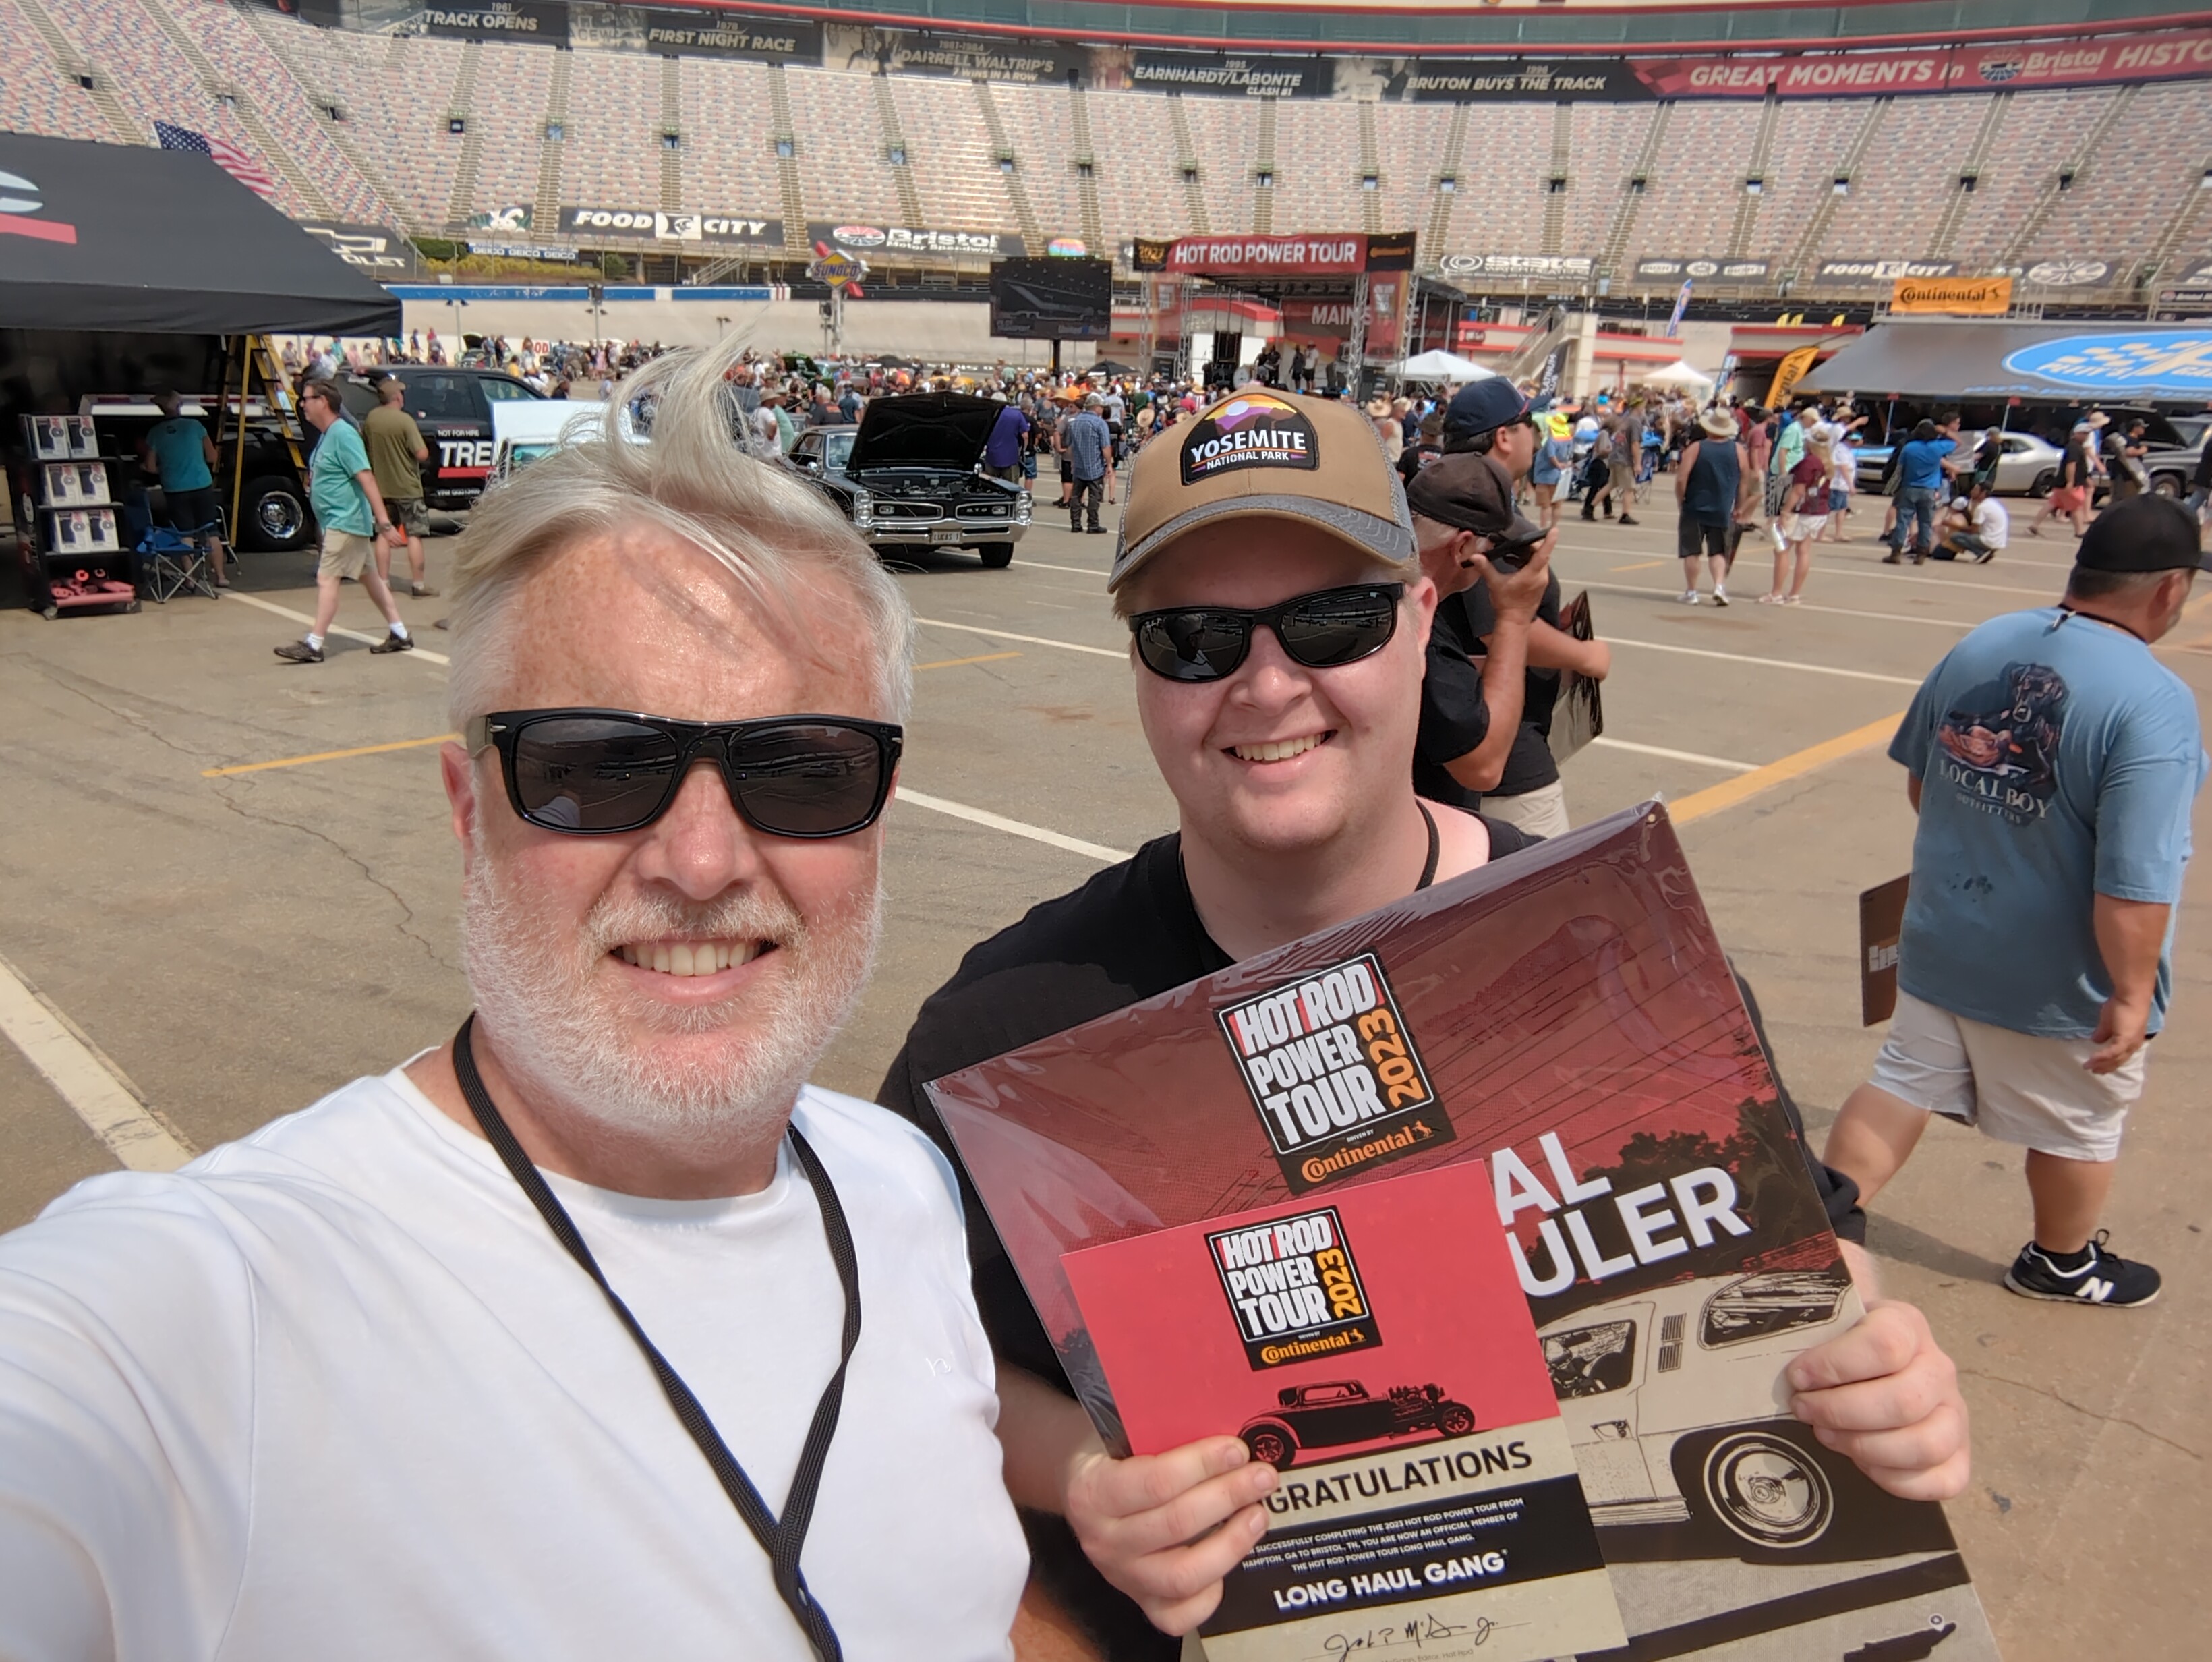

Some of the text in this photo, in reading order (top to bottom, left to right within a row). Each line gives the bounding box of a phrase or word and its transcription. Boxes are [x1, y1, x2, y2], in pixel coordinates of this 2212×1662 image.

[492, 2, 512, 11] 1961
[425, 10, 538, 30] TRACK OPENS
[649, 28, 796, 52] FIRST NIGHT RACE
[900, 49, 1055, 73] DARRELL WALTRIP'S
[1225, 59, 1246, 69] 1995
[1690, 65, 1786, 86] GREAT
[1786, 59, 1936, 86] MOMENTS
[2025, 47, 2108, 69] Bristol
[990, 70, 1001, 79] IN
[1002, 71, 1010, 80] A
[1012, 71, 1039, 82] ROW
[1134, 67, 1302, 86] EARNHARDT/LABONTE
[1407, 76, 1608, 91] BRUTON BUYS THE TRACK
[1246, 86, 1279, 96] CLASH
[575, 210, 767, 236] FOOD CITY
[887, 241, 999, 254] Motor Speedway
[888, 228, 1001, 248] Bristol
[473, 247, 505, 256] GEICO
[508, 248, 540, 258] GEICO
[544, 251, 576, 260] GEICO
[1175, 243, 1208, 264] HOT
[1209, 243, 1242, 264] ROD
[1245, 243, 1305, 264] POWER
[1308, 243, 1357, 263] TOUR
[814, 264, 858, 278] SUNOCO
[1822, 264, 1953, 277] FOOD CITY
[1900, 286, 1987, 304] Continental
[1190, 429, 1306, 463] YOSEMITE
[1206, 451, 1289, 470] NATIONAL PARK
[1939, 759, 2052, 819] LOCAL BOY
[1956, 792, 2021, 824] OUTFITTERS
[1234, 963, 1377, 1056] HOT ROD
[1247, 1023, 1364, 1097] POWER
[1358, 1008, 1426, 1108] 2023
[1264, 1064, 1387, 1146] TOUR
[1346, 1128, 1374, 1143] DRIVEN BY
[1302, 1124, 1416, 1182] Continental
[1221, 1215, 1334, 1269] HOT ROD
[1227, 1256, 1319, 1300] POWER
[1316, 1248, 1362, 1319] 2023
[1238, 1285, 1332, 1336] TOUR
[1261, 1331, 1351, 1364] Continental
[1263, 1441, 1532, 1514] GRATULATIONS
[1255, 1535, 1313, 1552] SUCCESSFULLY
[1314, 1527, 1367, 1541] COMPLETING
[1368, 1524, 1385, 1532] THE
[1385, 1521, 1404, 1530] 2023
[1404, 1517, 1422, 1526] HOT
[1424, 1513, 1442, 1522] ROD
[1443, 1508, 1474, 1519] POWER
[1474, 1503, 1497, 1513] TOUR
[1498, 1497, 1524, 1508] FROM
[1242, 1512, 1518, 1569] HAMPTON, GA TO BRISTOL, TN, YOU ARE NOW AN OFFICIAL MEMBER OF
[1291, 1533, 1475, 1572] THE HOT ROD POWER TOUR LONG HAUL GANG.
[1274, 1579, 1347, 1611] LONG
[1350, 1568, 1422, 1597] HAUL
[1458, 1648, 1474, 1656] Rod
